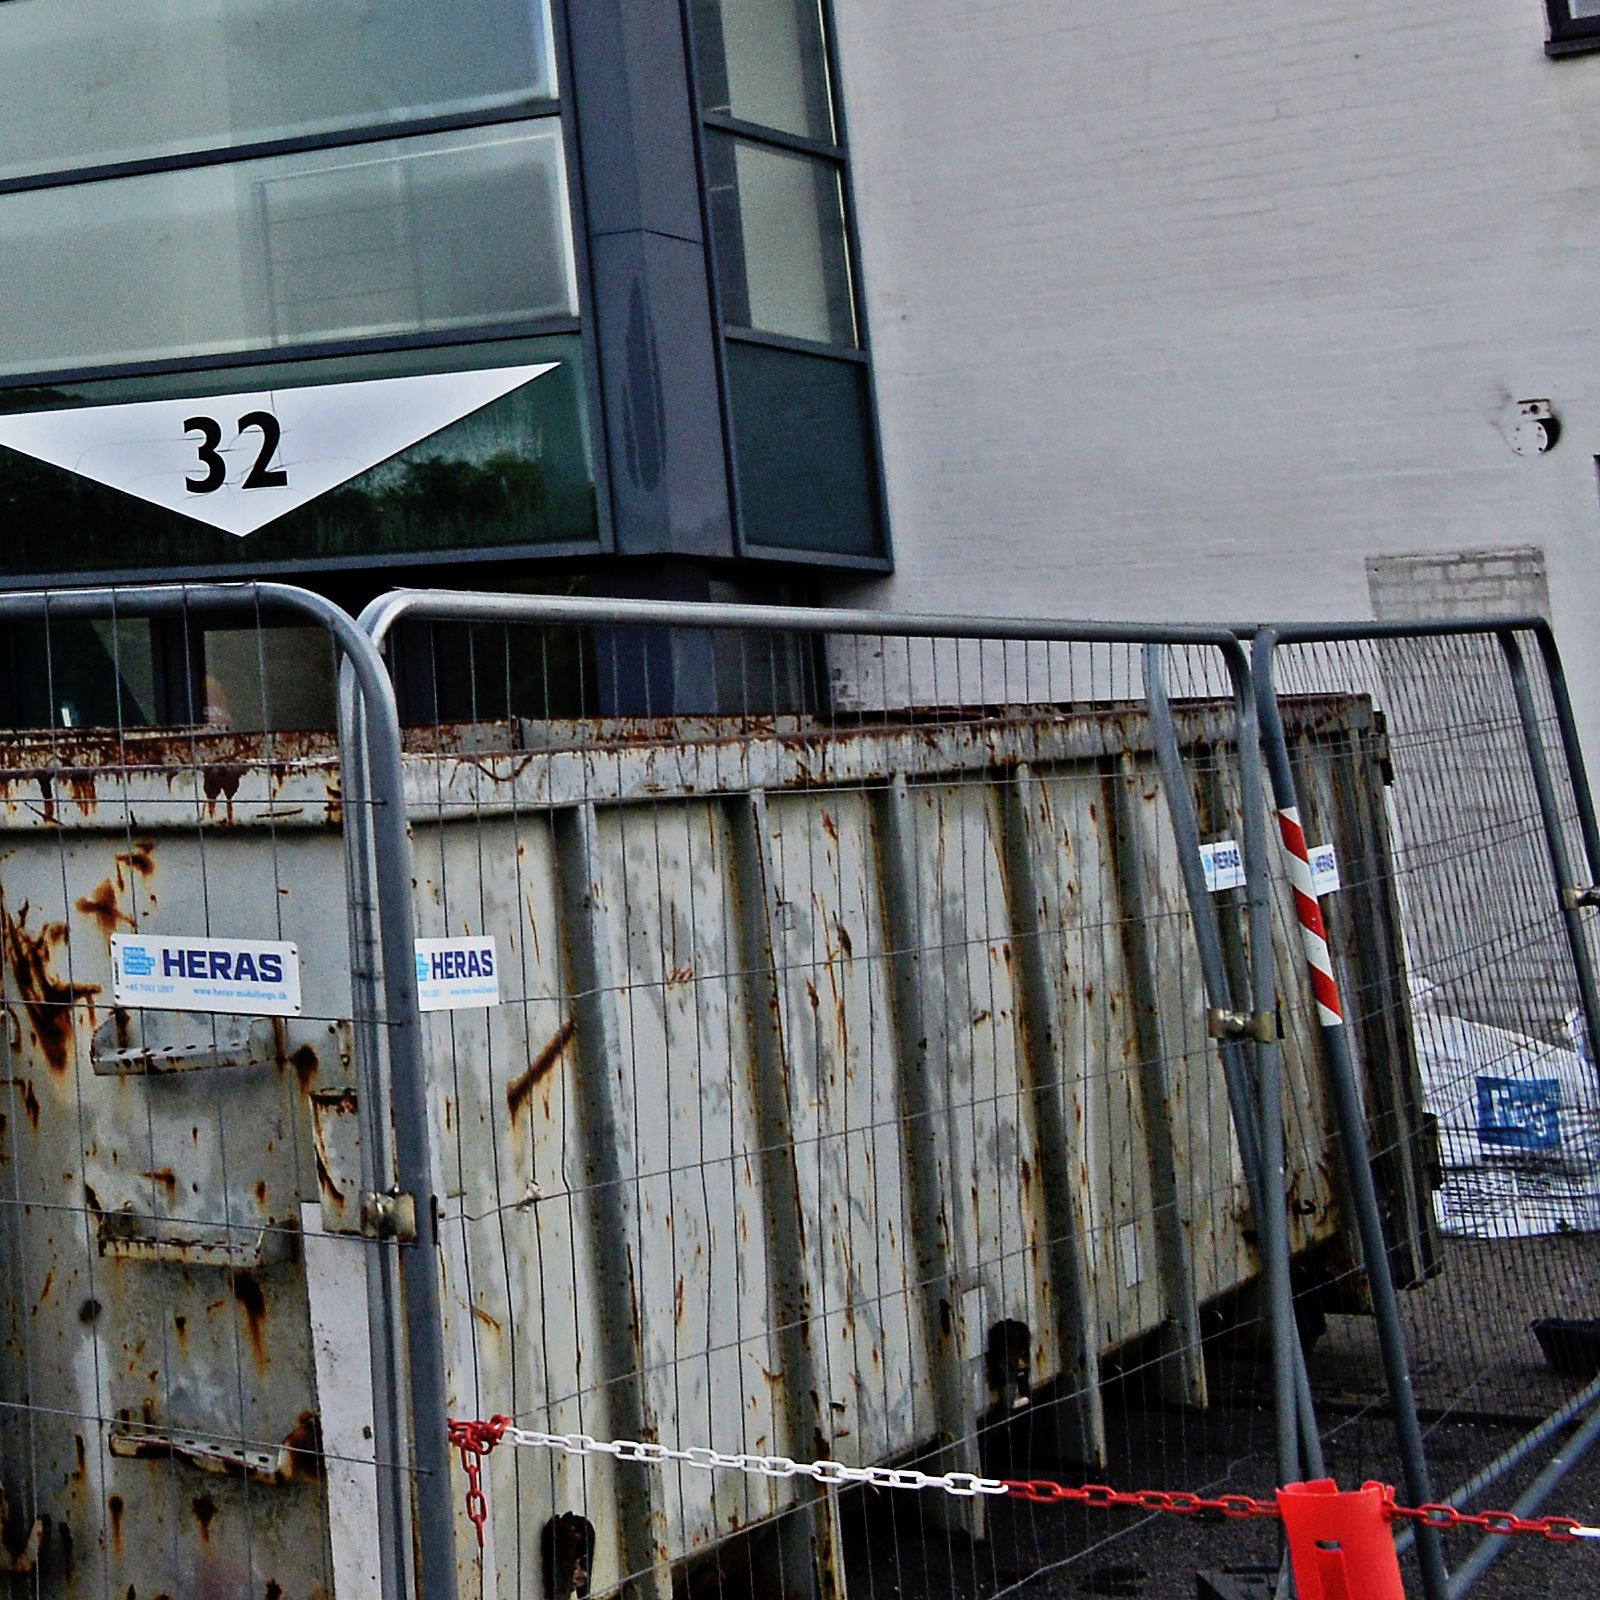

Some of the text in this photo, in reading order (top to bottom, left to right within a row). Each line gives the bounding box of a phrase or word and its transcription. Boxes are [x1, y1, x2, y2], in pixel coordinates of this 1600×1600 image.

[182, 411, 288, 494] 32
[162, 948, 283, 983] HERAS
[431, 949, 494, 980] HERAS
